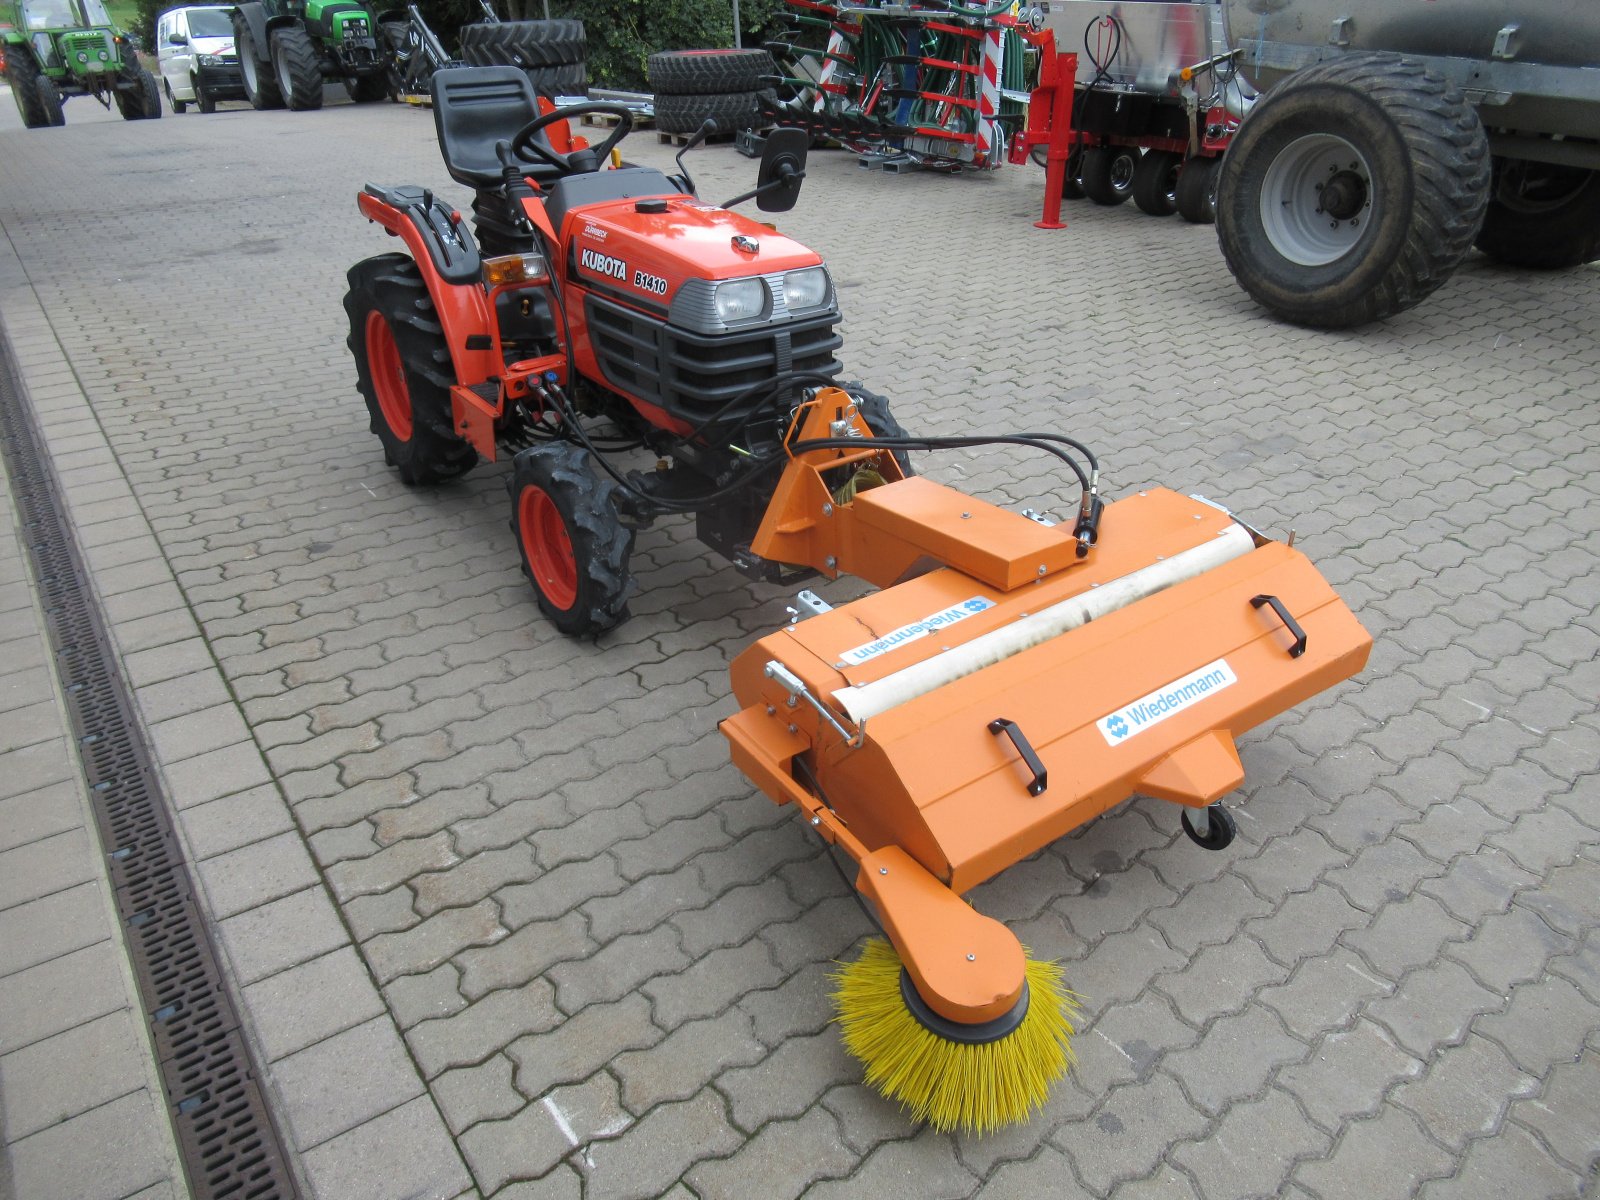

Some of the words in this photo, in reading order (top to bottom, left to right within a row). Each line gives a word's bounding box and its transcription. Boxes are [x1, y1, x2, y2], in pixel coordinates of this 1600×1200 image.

[581, 248, 627, 281] KUBOTA
[634, 270, 667, 295] B1410
[853, 609, 968, 659] Wiedenmann
[1126, 669, 1226, 726] Wiedenmann
